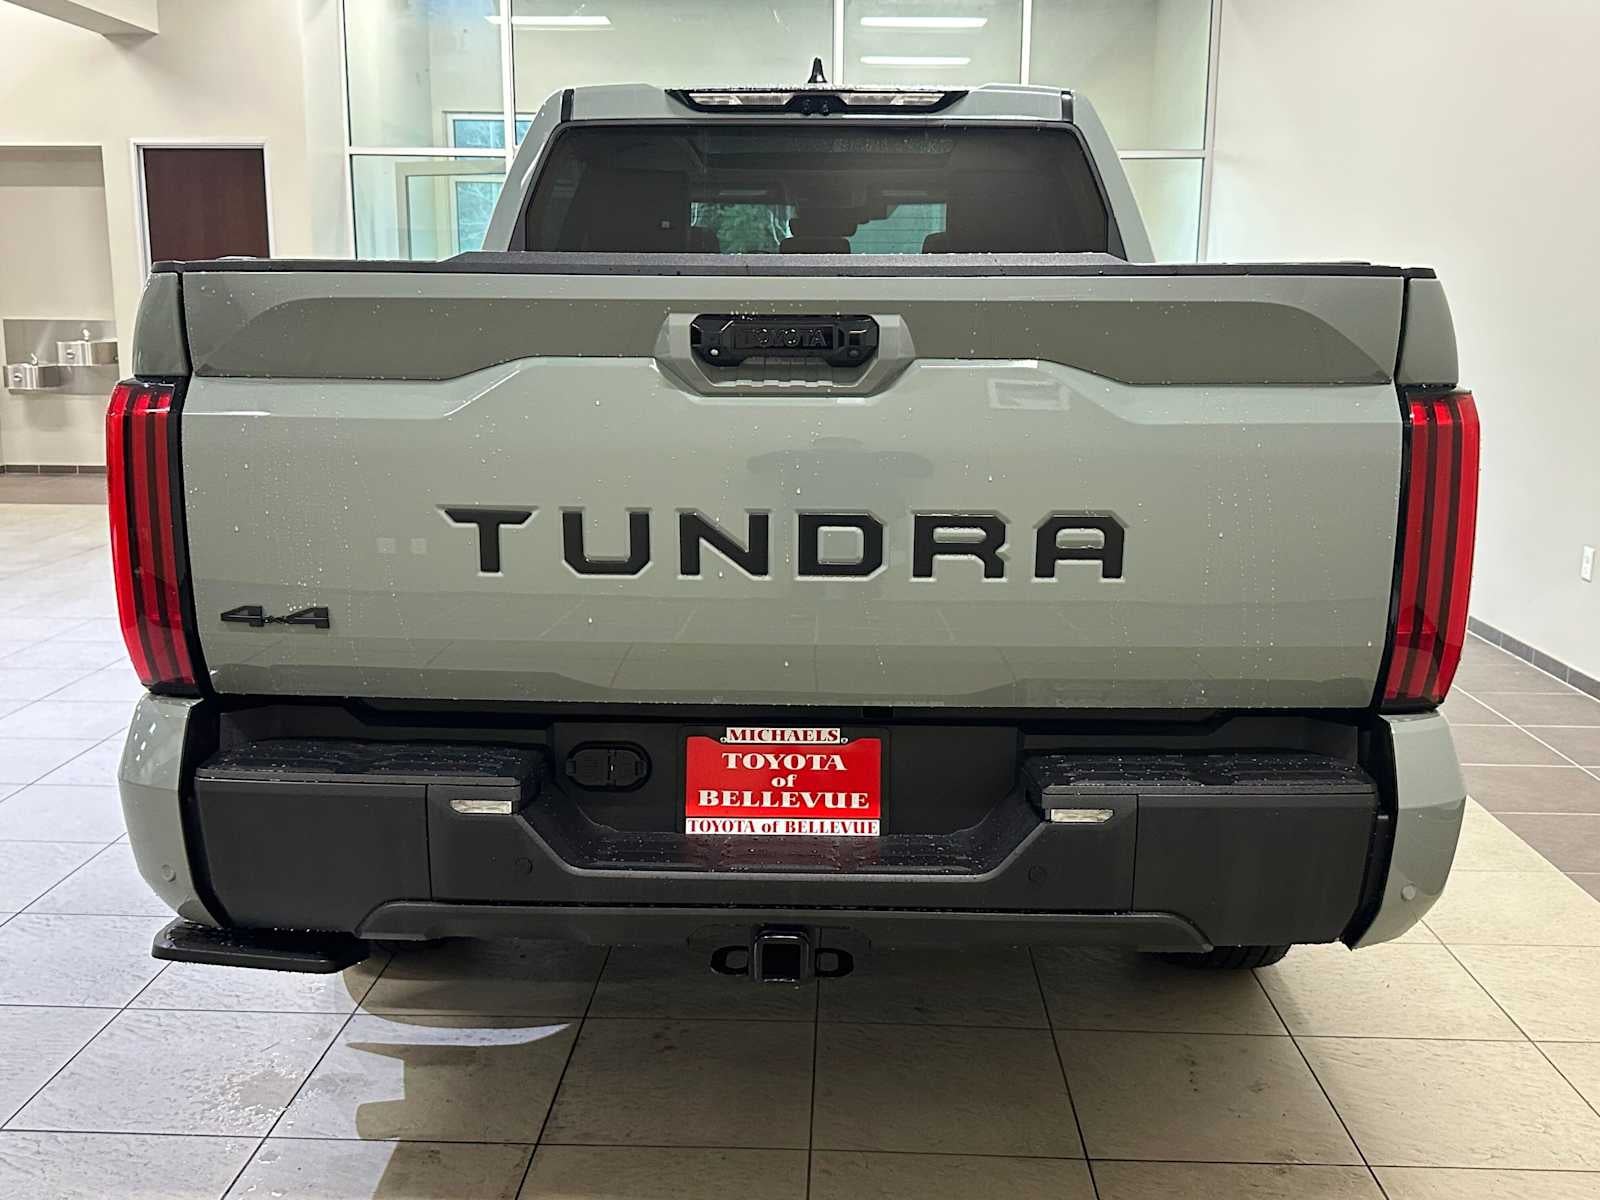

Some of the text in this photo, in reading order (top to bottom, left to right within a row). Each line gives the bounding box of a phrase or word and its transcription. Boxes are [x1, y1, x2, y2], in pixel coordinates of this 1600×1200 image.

[440, 506, 1127, 582] TUNDRA
[728, 729, 839, 742] MICHAELS
[721, 752, 847, 771] TOYOTA
[771, 774, 798, 788] of
[698, 790, 870, 809] BELLEVUE
[688, 819, 878, 835] TOYOTA of BELLEVUE
